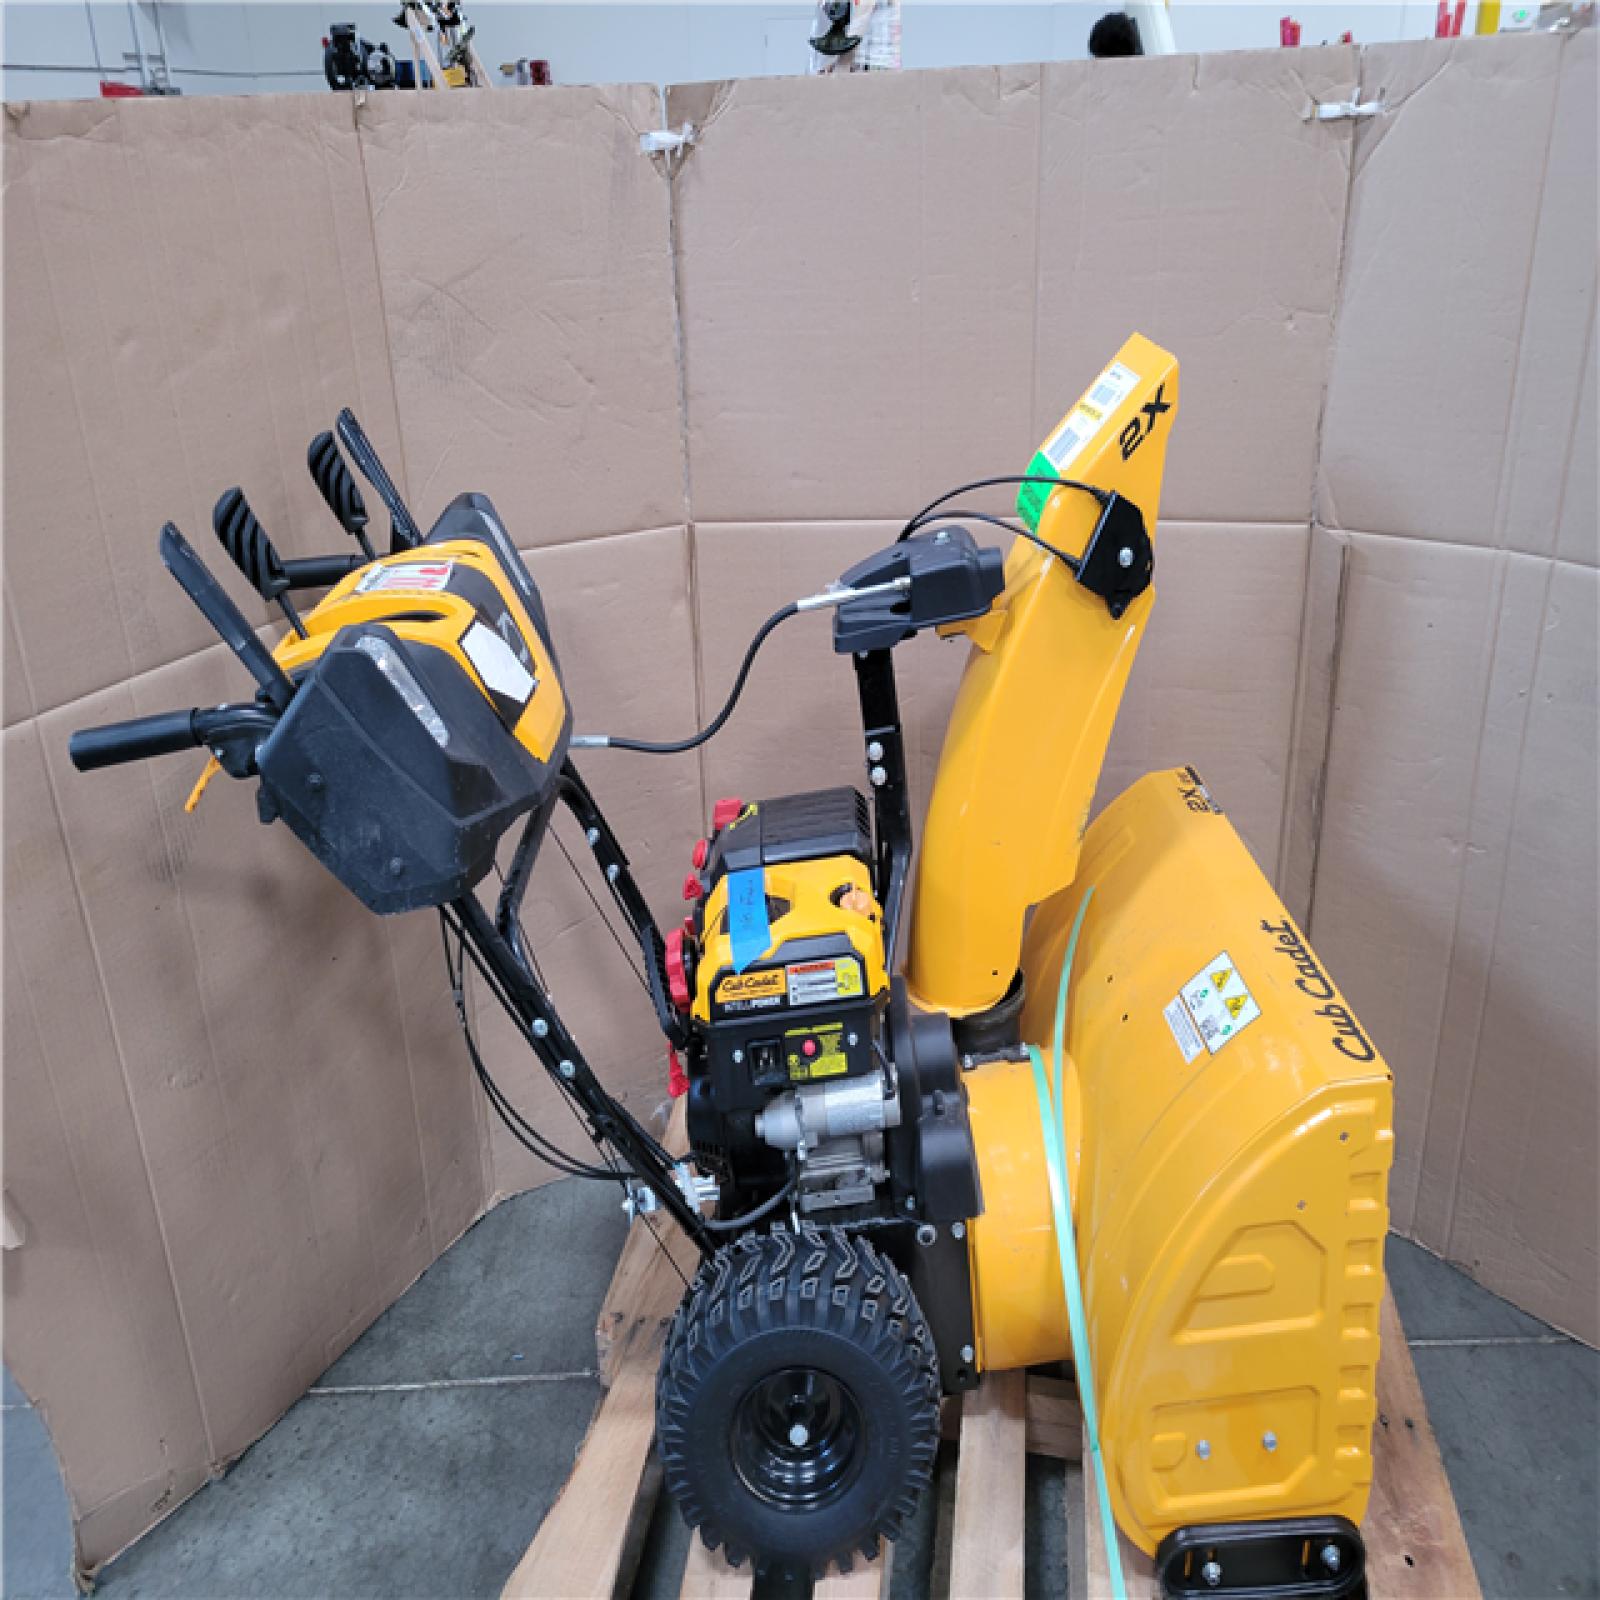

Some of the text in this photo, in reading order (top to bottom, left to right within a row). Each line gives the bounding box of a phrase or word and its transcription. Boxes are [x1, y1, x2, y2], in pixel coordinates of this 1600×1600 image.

[1119, 381, 1171, 462] 2X
[1260, 918, 1376, 1062] Cub Cadet
